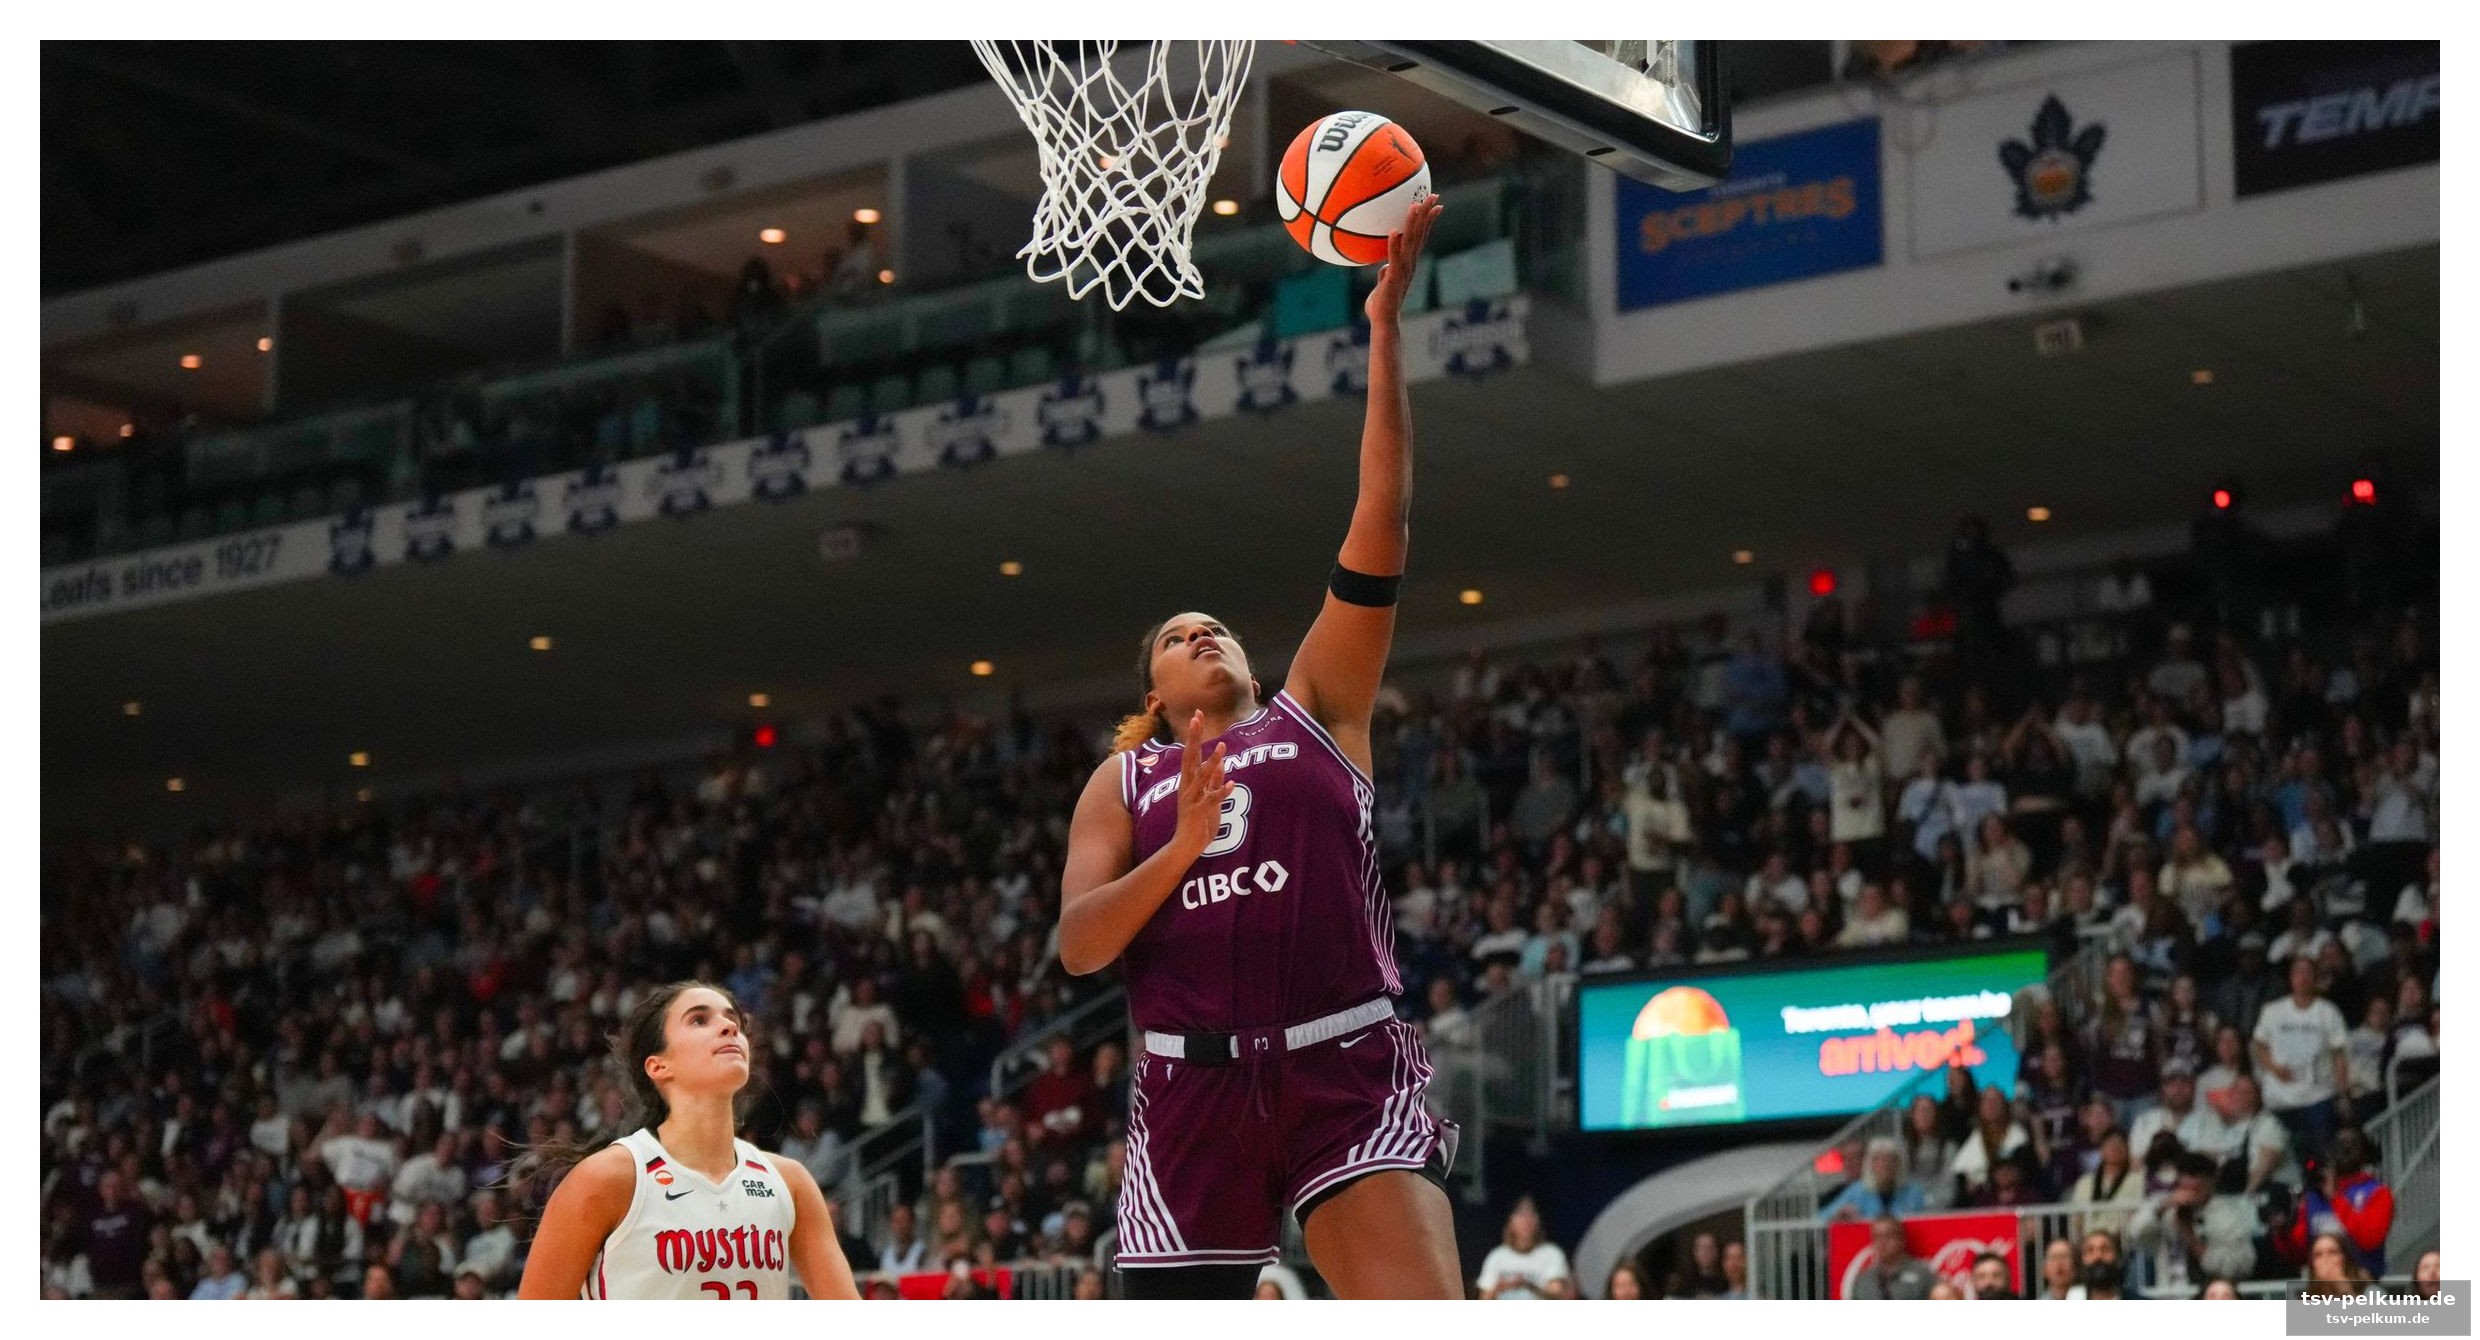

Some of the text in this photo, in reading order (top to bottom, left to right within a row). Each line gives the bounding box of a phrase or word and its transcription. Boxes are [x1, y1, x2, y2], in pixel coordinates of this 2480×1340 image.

[122, 554, 203, 597] since
[217, 533, 281, 578] 1927
[1138, 742, 1299, 817] TONTO
[1182, 867, 1252, 910] CIBC
[742, 1179, 766, 1189] CAR
